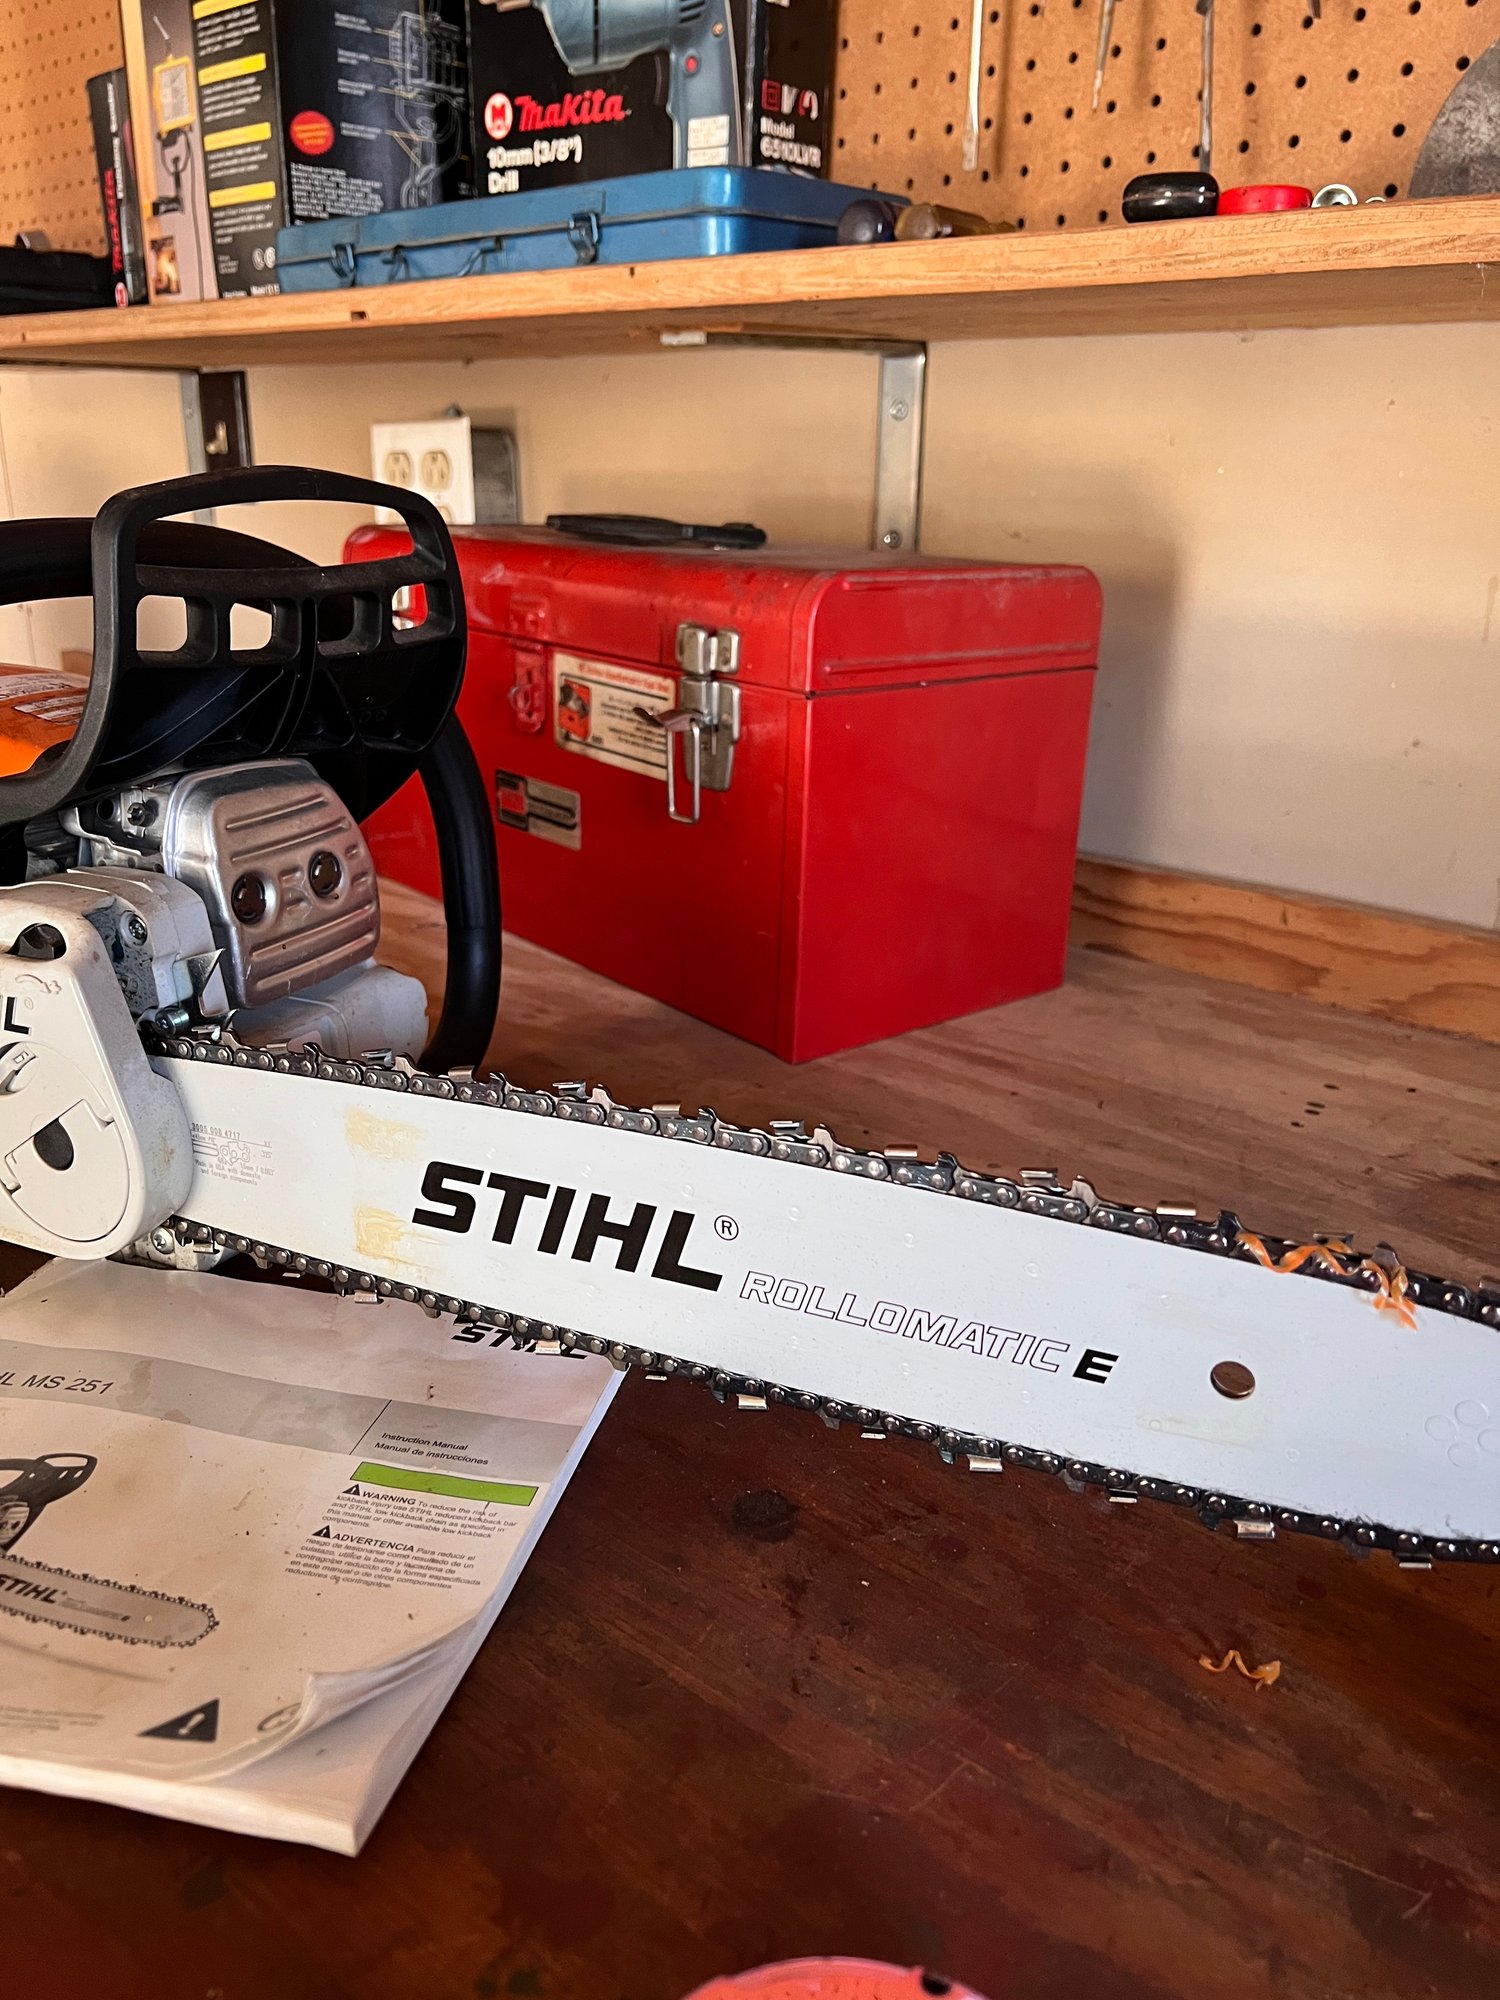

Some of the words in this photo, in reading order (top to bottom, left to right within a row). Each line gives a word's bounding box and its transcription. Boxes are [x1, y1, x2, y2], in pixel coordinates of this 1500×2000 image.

[515, 89, 625, 132] Makita
[488, 169, 519, 194] Drill
[412, 1160, 723, 1292] STIHL
[740, 1270, 1070, 1373] ROLLOMATIC
[1072, 1349, 1119, 1384] E
[21, 1374, 66, 1388] MS
[64, 1378, 114, 1394] 251
[382, 1432, 430, 1446] Instruction
[432, 1440, 468, 1450] Manual
[374, 1442, 410, 1453] Manual
[412, 1448, 424, 1456] de
[426, 1450, 488, 1465] instrucciones
[336, 1496, 369, 1504] kickback
[370, 1501, 392, 1510] injury
[408, 1506, 432, 1516] STIHL
[434, 1512, 467, 1520] reduced
[468, 1516, 501, 1524] kickback
[362, 1491, 416, 1504] WARNING
[430, 1504, 456, 1512] reduce
[342, 1512, 372, 1520] manual
[383, 1518, 404, 1526] other
[405, 1522, 440, 1531] available
[457, 1530, 492, 1538] kickback
[348, 1504, 372, 1513] STIHL
[390, 1510, 423, 1522] kickback
[426, 1518, 447, 1526] chain
[460, 1523, 496, 1532] specified
[306, 1538, 330, 1546] riesgo
[344, 1544, 386, 1555] lesionarse
[332, 1534, 414, 1552] ADVERTENCIA
[437, 1551, 465, 1560] reducir
[344, 1560, 380, 1570] reducido
[404, 1570, 427, 1578] forma
[372, 1557, 394, 1565] barra
[284, 1568, 328, 1578] reductores
[322, 1565, 353, 1574] manual
[374, 1573, 394, 1582] otros
